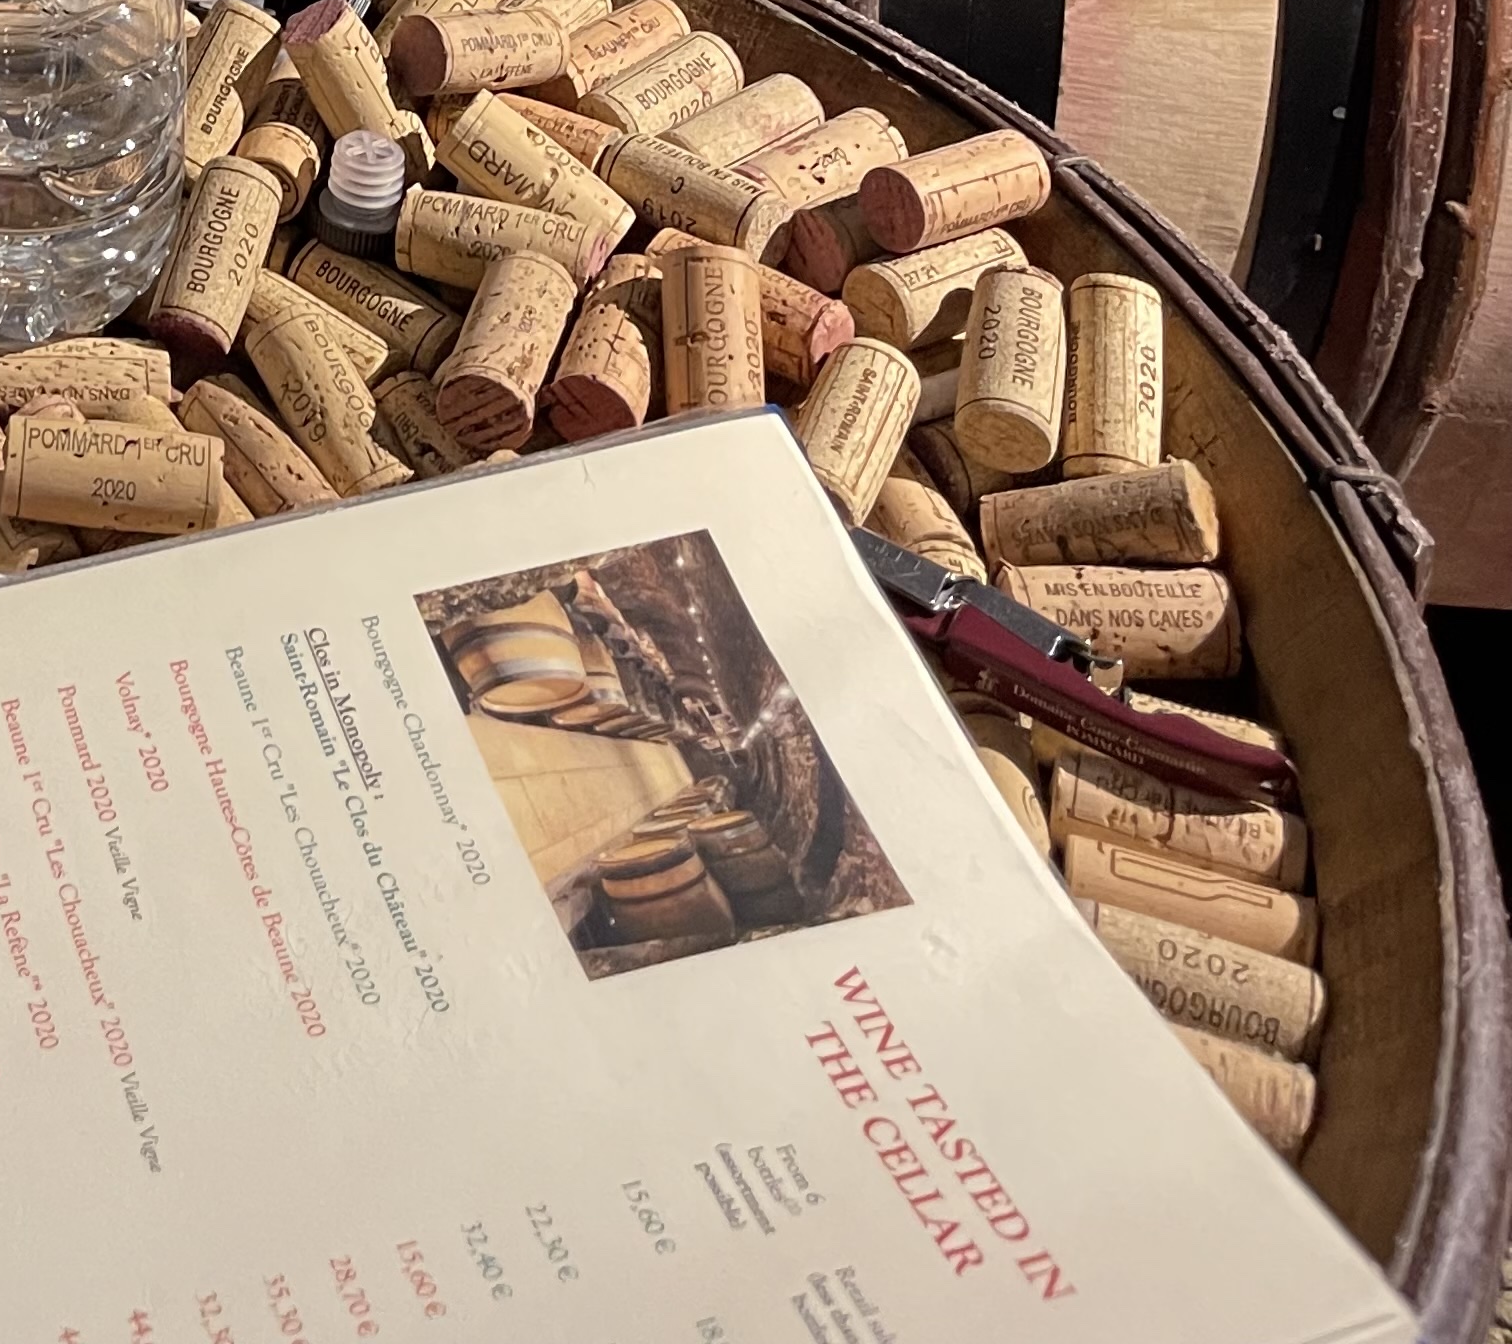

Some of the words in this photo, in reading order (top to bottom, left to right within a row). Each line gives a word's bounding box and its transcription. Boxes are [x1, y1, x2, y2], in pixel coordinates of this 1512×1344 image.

[199, 45, 251, 136] BOURGOGNE
[634, 48, 717, 112] BOURGOGNE
[665, 87, 716, 127] 2020
[185, 183, 241, 296] BOURGOGNE
[224, 221, 261, 287] 2020
[417, 192, 510, 225] POMMARD
[540, 217, 582, 243] CRU
[312, 257, 415, 333] BOURGOGNE
[976, 302, 1001, 362] 2020
[703, 265, 728, 407] OURGOGNE
[1010, 285, 1044, 390] BOURGOGNE
[303, 317, 381, 432] BOURGOG
[829, 367, 878, 455] SAINT-ROMAIN
[1136, 344, 1156, 418] 2020
[27, 426, 126, 455] POMMARD
[163, 441, 206, 467] CRU
[90, 477, 136, 502] 2020
[1055, 608, 1103, 626] DANS
[1108, 608, 1144, 626] NOS
[1149, 608, 1203, 628] CAVES
[1110, 581, 1202, 598] BOUTEILLE
[302, 627, 332, 675] Clos
[319, 670, 341, 696] in
[168, 659, 213, 756] Bourgogne
[327, 692, 383, 793] Monopoly
[137, 743, 170, 793] 2020
[360, 614, 409, 710] Bourgogne
[455, 838, 491, 886] 2020
[56, 683, 103, 772] Pommard
[86, 773, 117, 823] 2020
[104, 825, 131, 875] Vieille
[121, 876, 143, 921] Vigne
[204, 757, 259, 882] Hautes-Côtes
[224, 645, 258, 713] Beaune
[262, 743, 285, 781] Cru
[279, 783, 301, 824] "Les
[294, 826, 362, 952] Chouacheux"
[345, 955, 381, 1006] 2020
[279, 632, 337, 758] Saint-Romain
[344, 795, 370, 838] Clos
[362, 841, 384, 869] du
[413, 963, 450, 1015] 2020
[251, 884, 273, 909] de
[0, 697, 31, 766] Beaune
[31, 797, 53, 838] Cru
[45, 838, 66, 881] "Les
[58, 882, 116, 1010] Chouacheux"
[99, 1016, 134, 1067] 2020
[120, 1070, 149, 1123] Vieille
[139, 1124, 162, 1174] Vigne
[260, 911, 300, 985] Beaune
[1155, 937, 1250, 984] 2020
[26, 997, 60, 1050] 2020
[290, 987, 327, 1038] 2020
[804, 1019, 880, 1111] THE
[861, 1116, 985, 1278] CELLAR
[833, 964, 923, 1081] WINE
[905, 1082, 1031, 1243] TASTED
[1014, 1249, 1077, 1302] IN
